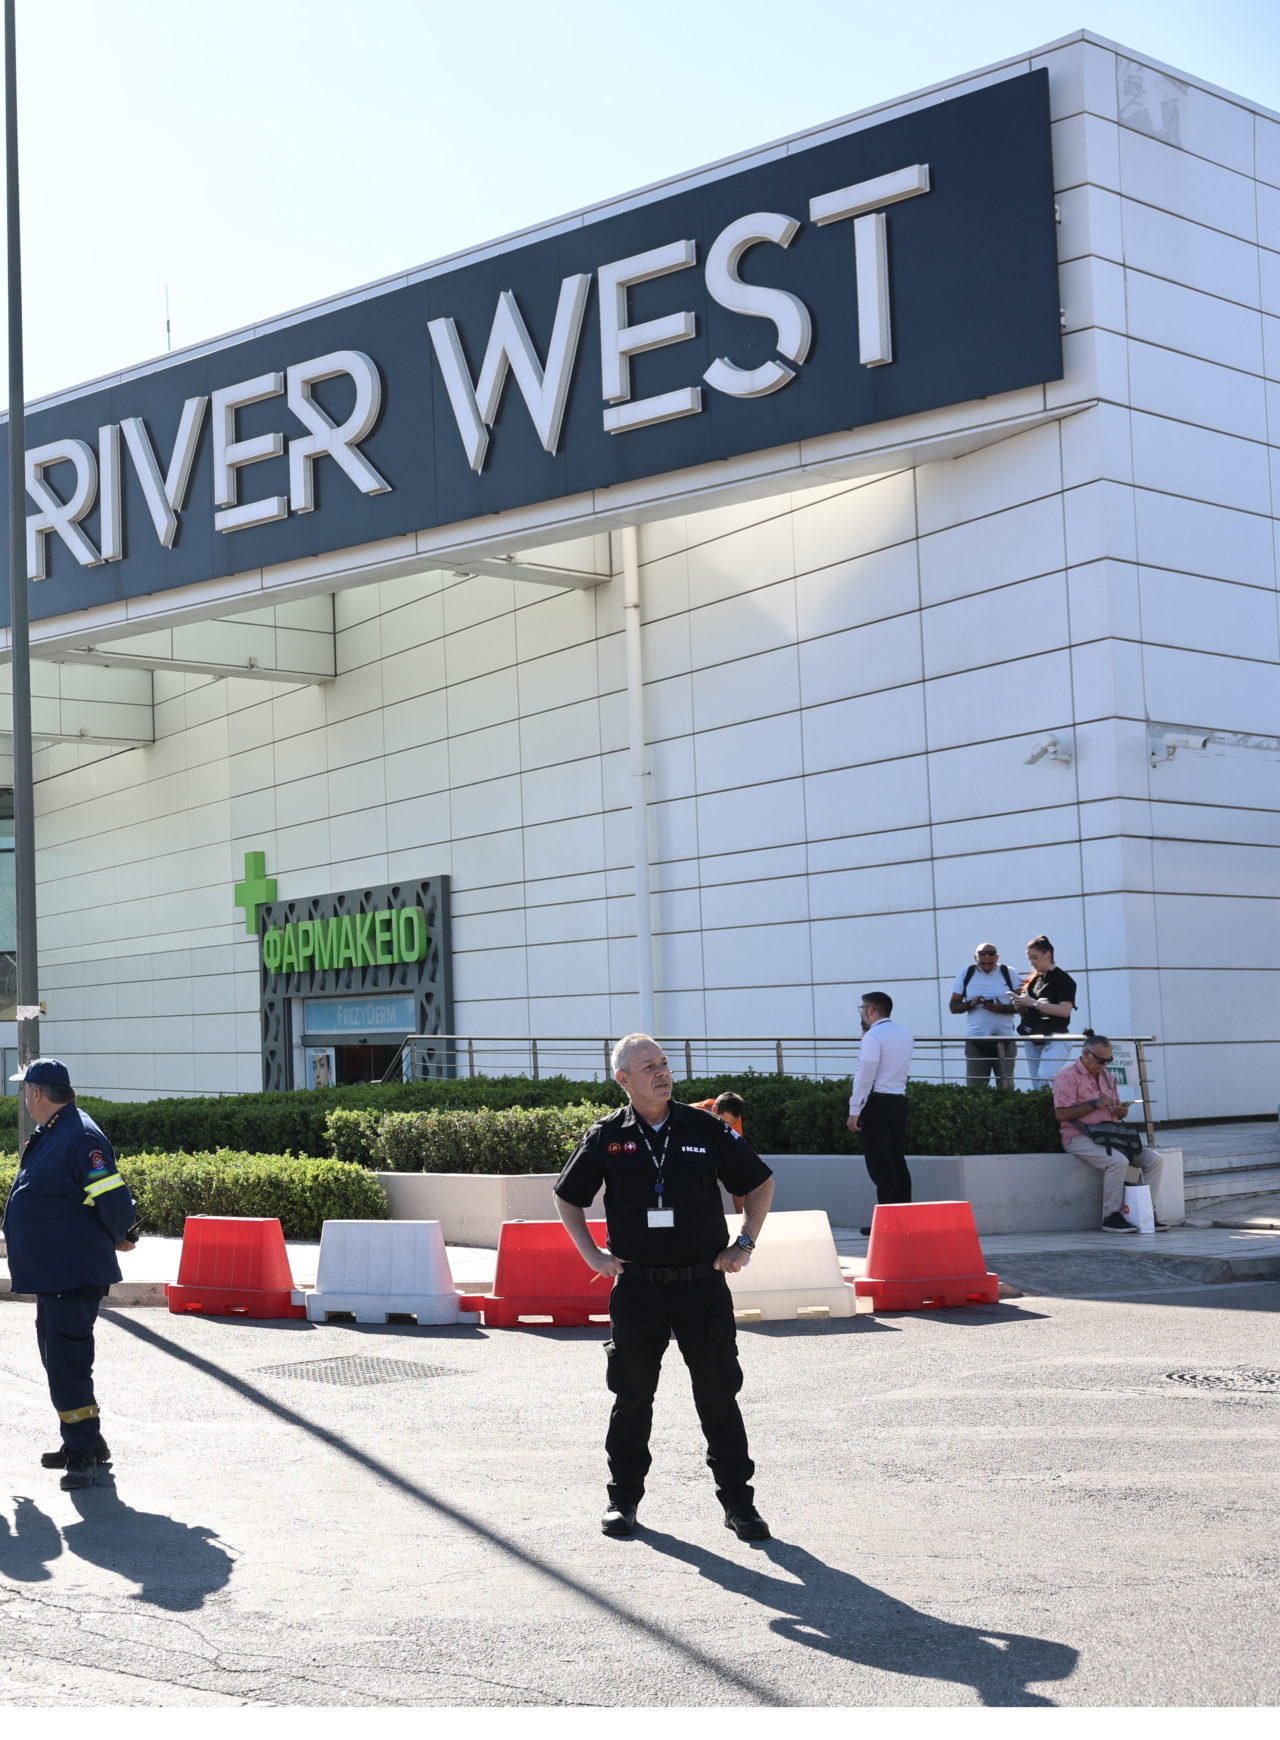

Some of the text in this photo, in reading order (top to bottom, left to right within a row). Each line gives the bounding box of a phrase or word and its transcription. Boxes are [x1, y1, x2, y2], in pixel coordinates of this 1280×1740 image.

[26, 162, 931, 581] RIVER WEST
[263, 906, 427, 974] ΦΑΡΜΑΚΕΙΟ
[681, 1144, 706, 1153] IKEA
